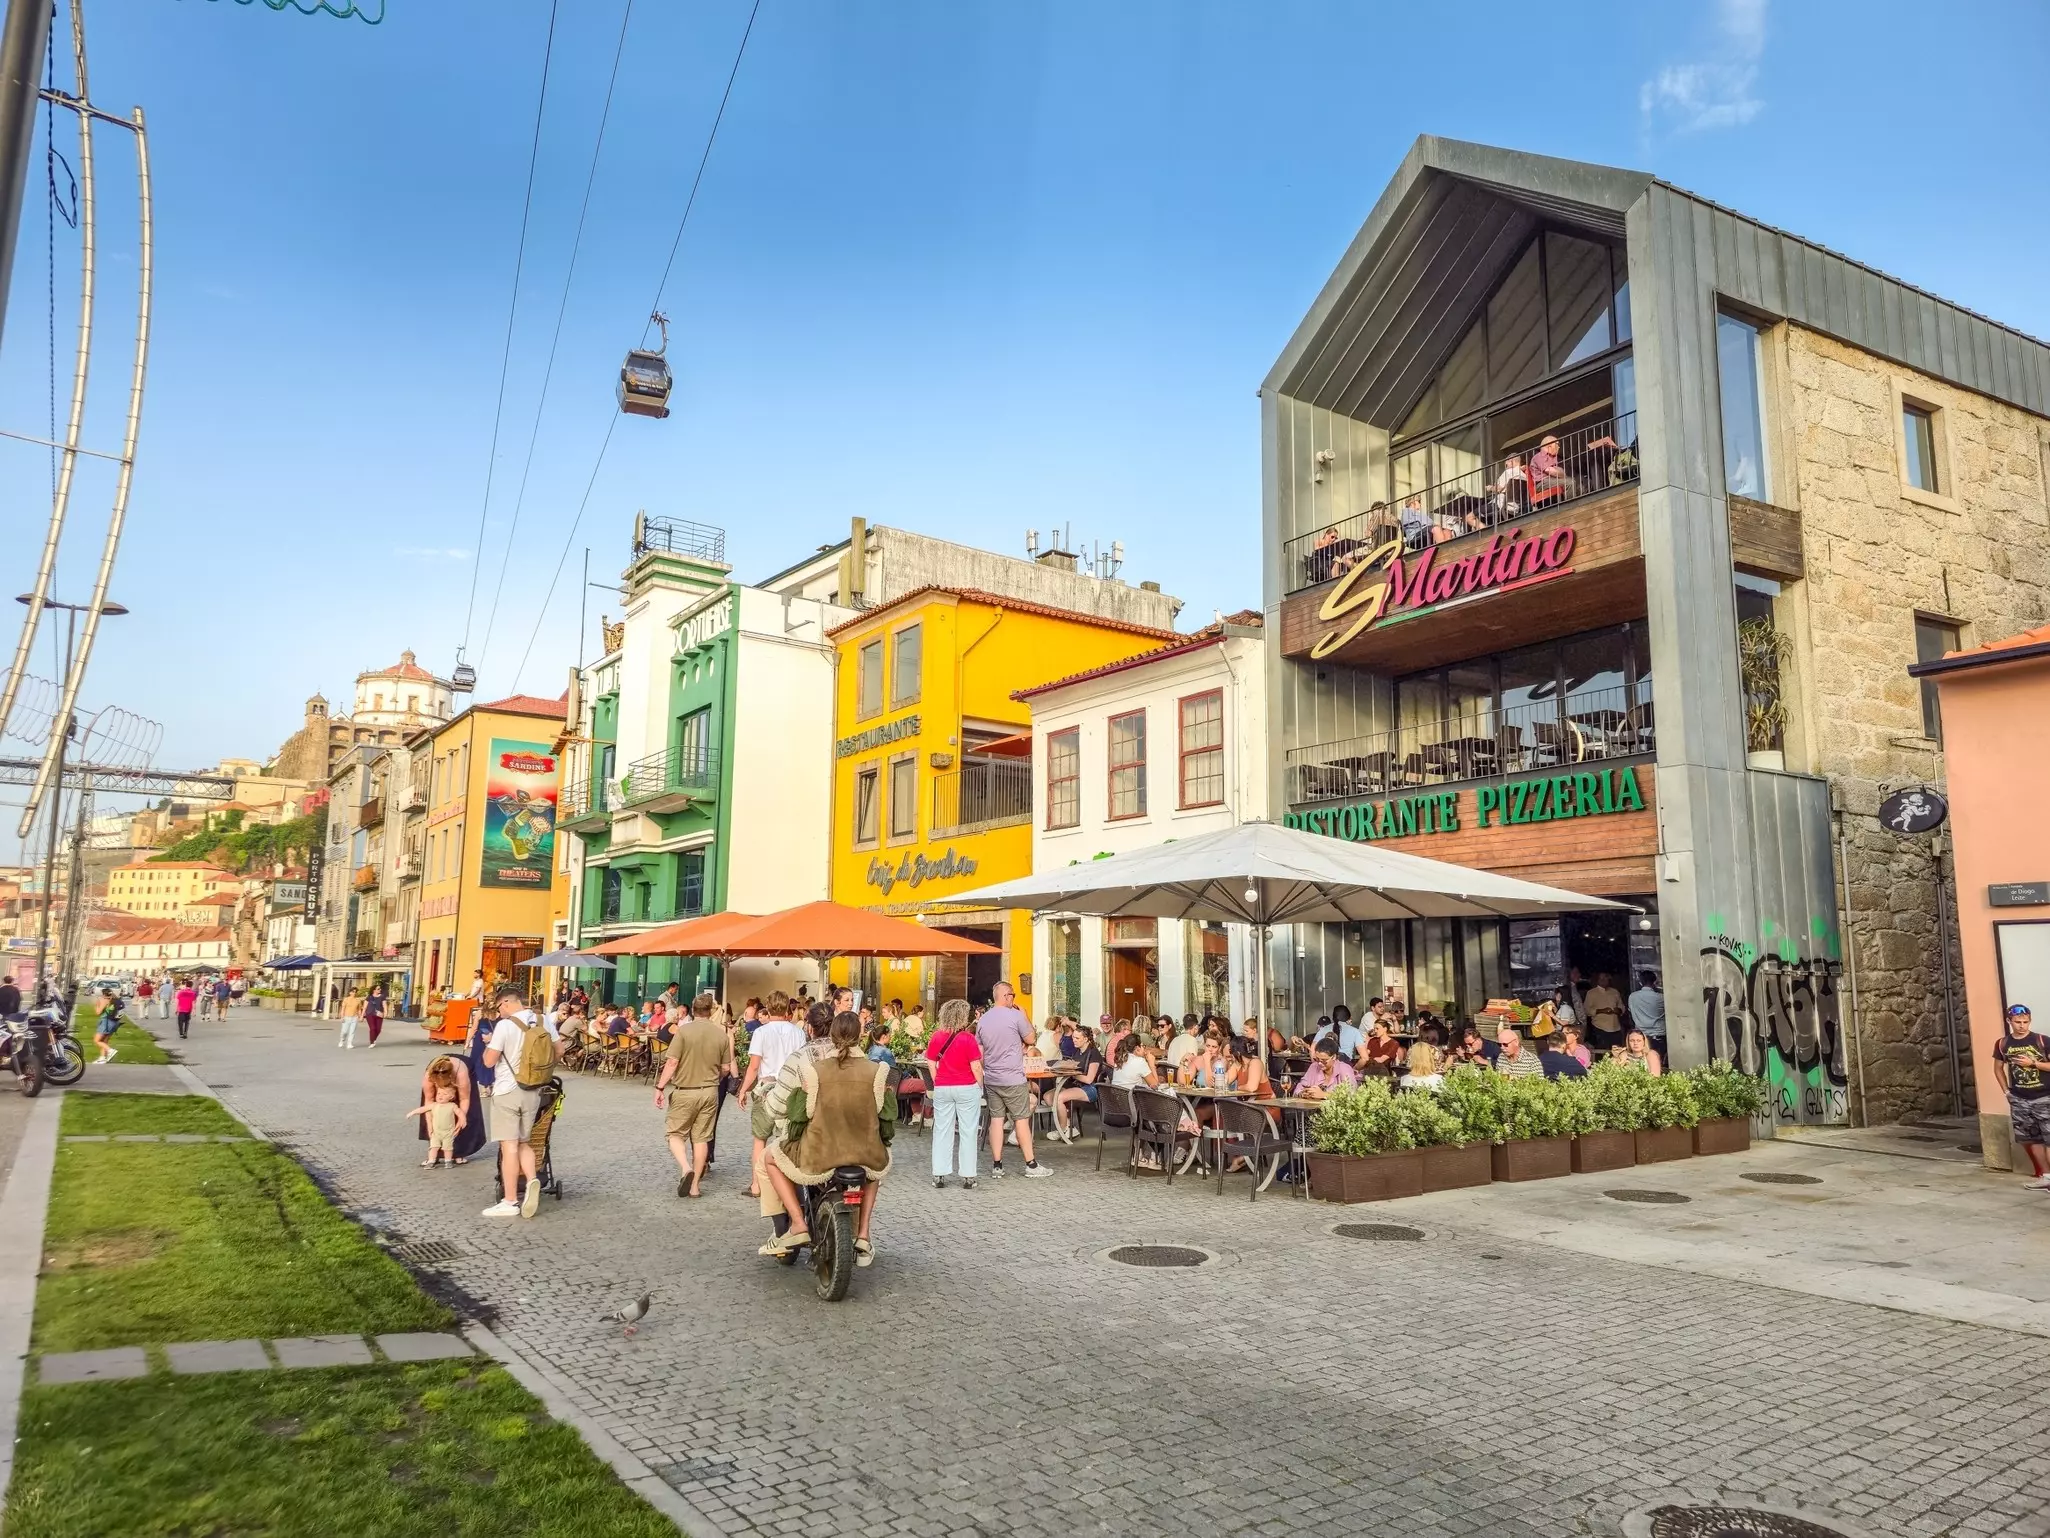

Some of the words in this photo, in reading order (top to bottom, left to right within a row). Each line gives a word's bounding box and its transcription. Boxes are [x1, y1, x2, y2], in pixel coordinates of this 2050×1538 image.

[1376, 527, 1577, 618] Martino
[836, 714, 922, 758] RESTAURANTE
[509, 761, 545, 771] SARDINE
[1283, 793, 1460, 842] RISTORANTE
[1477, 766, 1646, 828] PIZZERIA
[310, 852, 320, 884] PORTO
[307, 886, 318, 918] CRUZ
